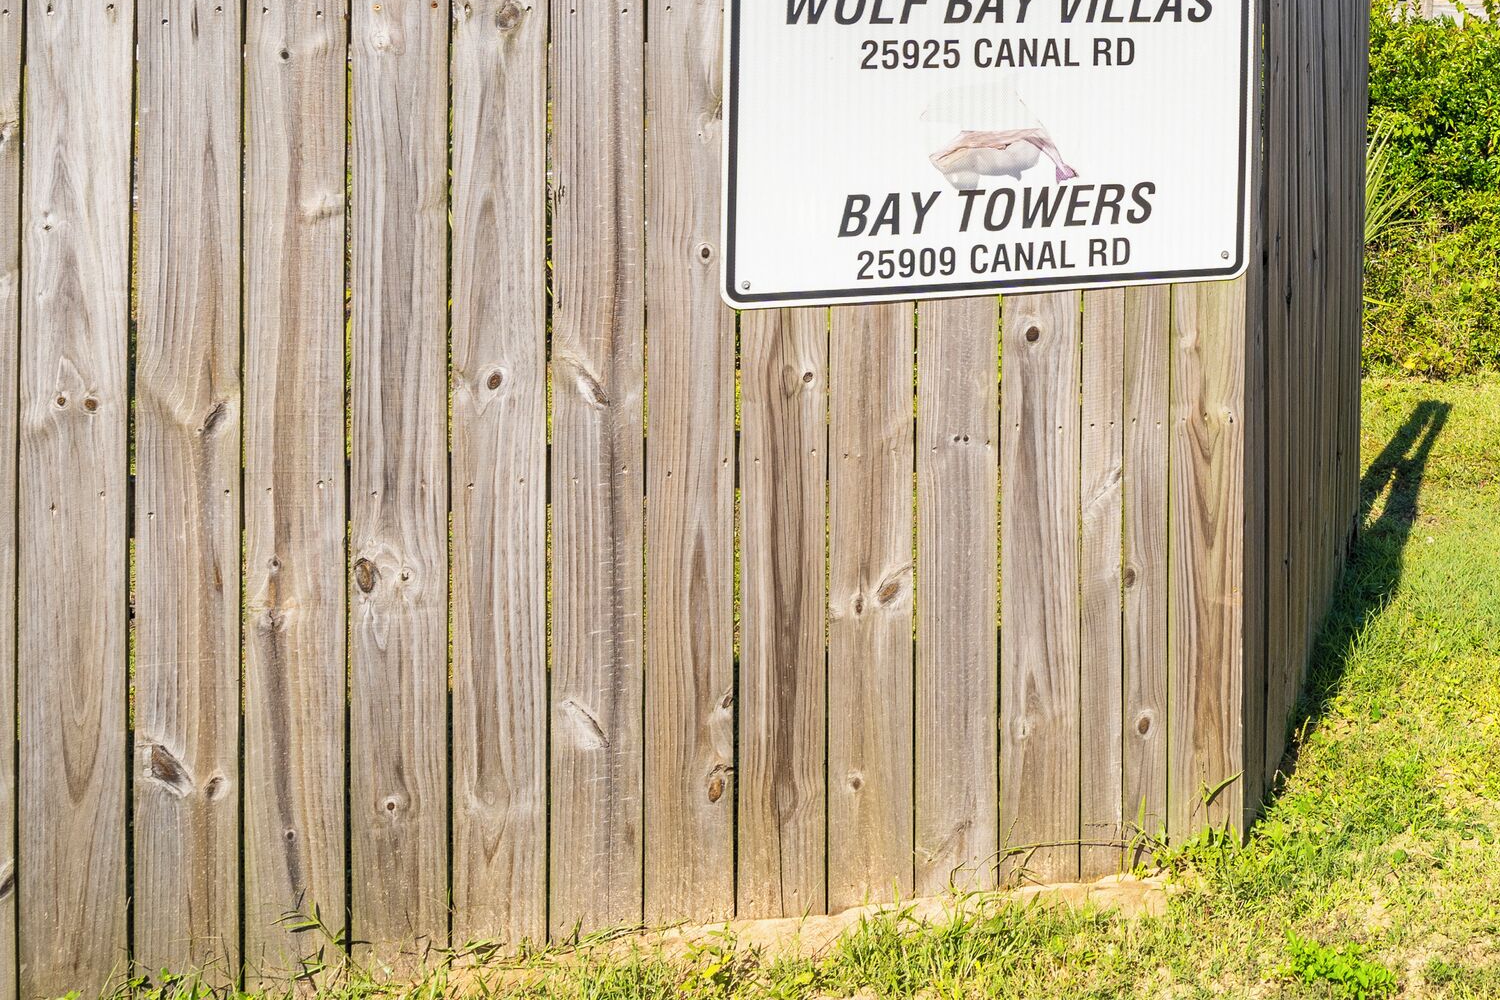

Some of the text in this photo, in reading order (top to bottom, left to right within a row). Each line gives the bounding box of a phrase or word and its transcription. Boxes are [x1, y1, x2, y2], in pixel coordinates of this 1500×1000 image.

[860, 37, 1135, 70] 25925 CANAL RD
[837, 181, 1156, 238] BAY TOWERS
[856, 237, 1130, 280] 25909 CANAL RD
